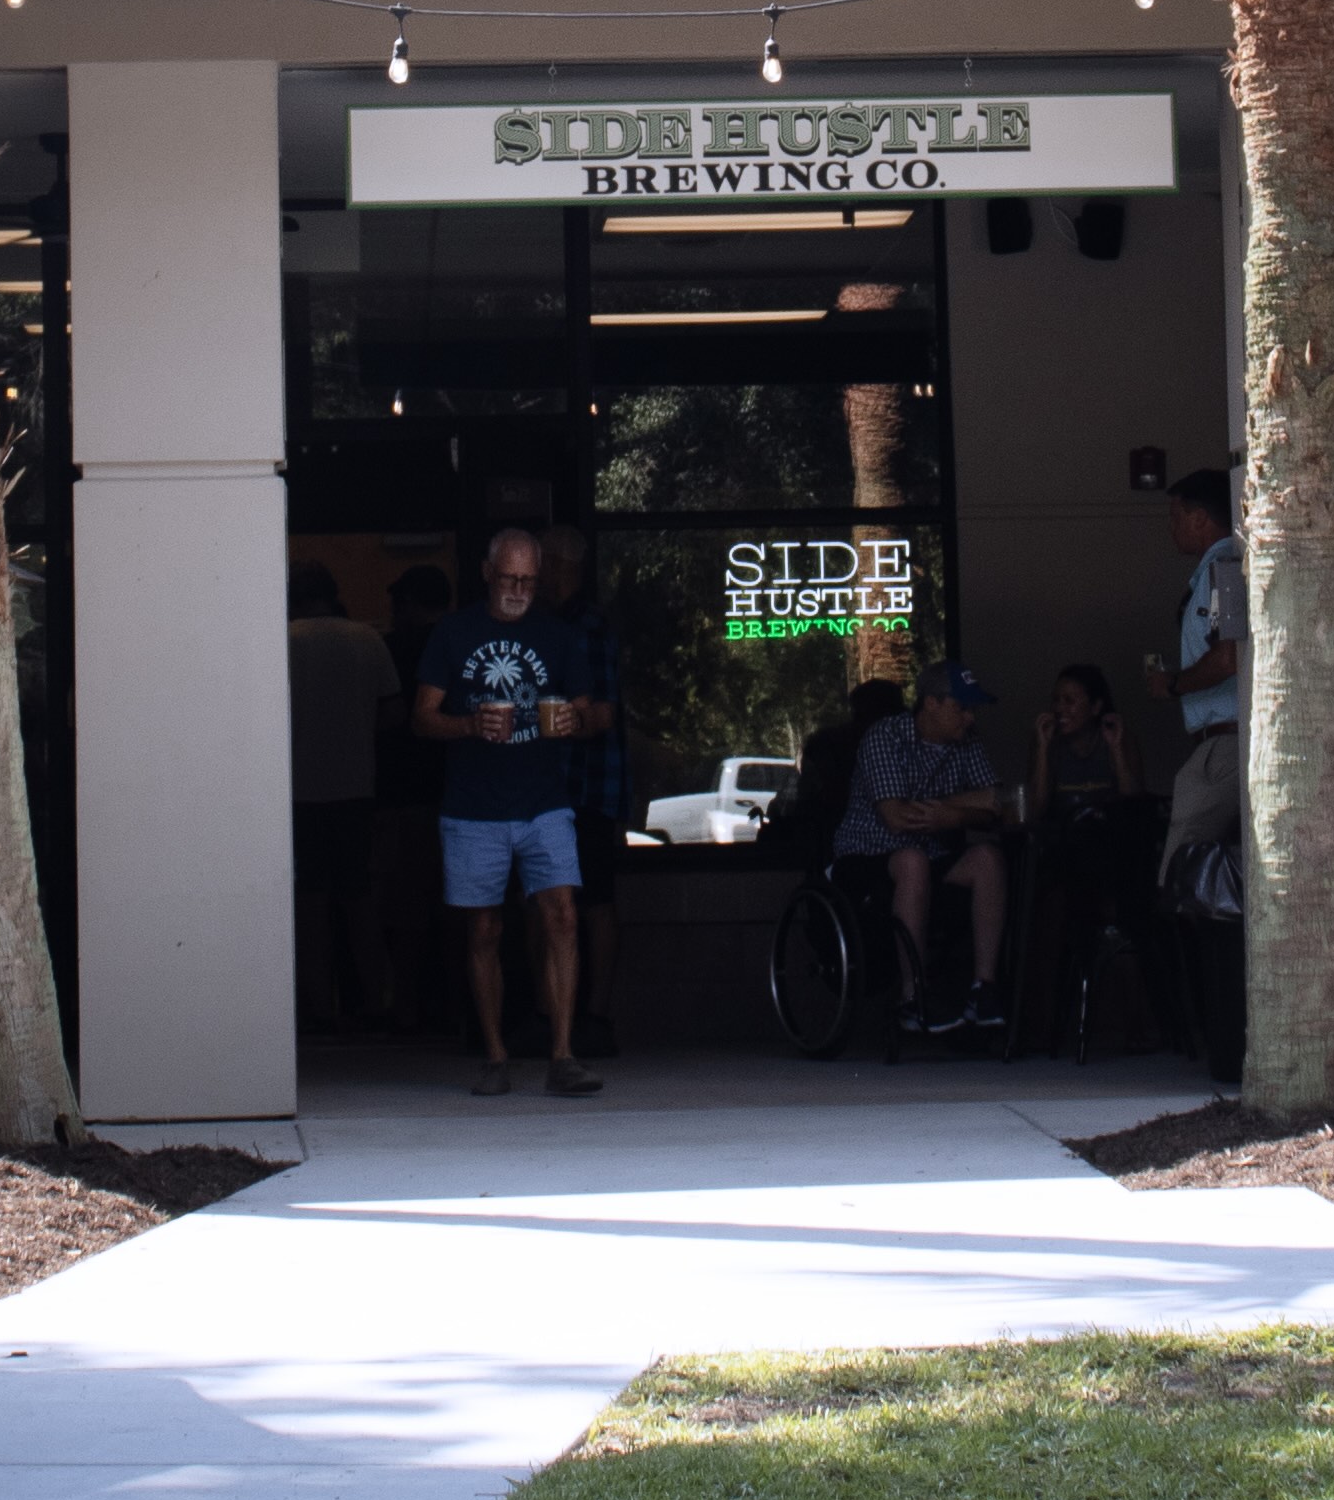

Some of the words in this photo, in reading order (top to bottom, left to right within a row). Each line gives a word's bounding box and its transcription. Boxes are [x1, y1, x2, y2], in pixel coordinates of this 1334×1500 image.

[581, 161, 854, 196] BREWING
[866, 159, 946, 191] CO.
[725, 539, 911, 587] SIDE
[724, 586, 913, 617] HUSTLE
[462, 640, 522, 681] BETTER
[523, 648, 549, 687] DAYS
